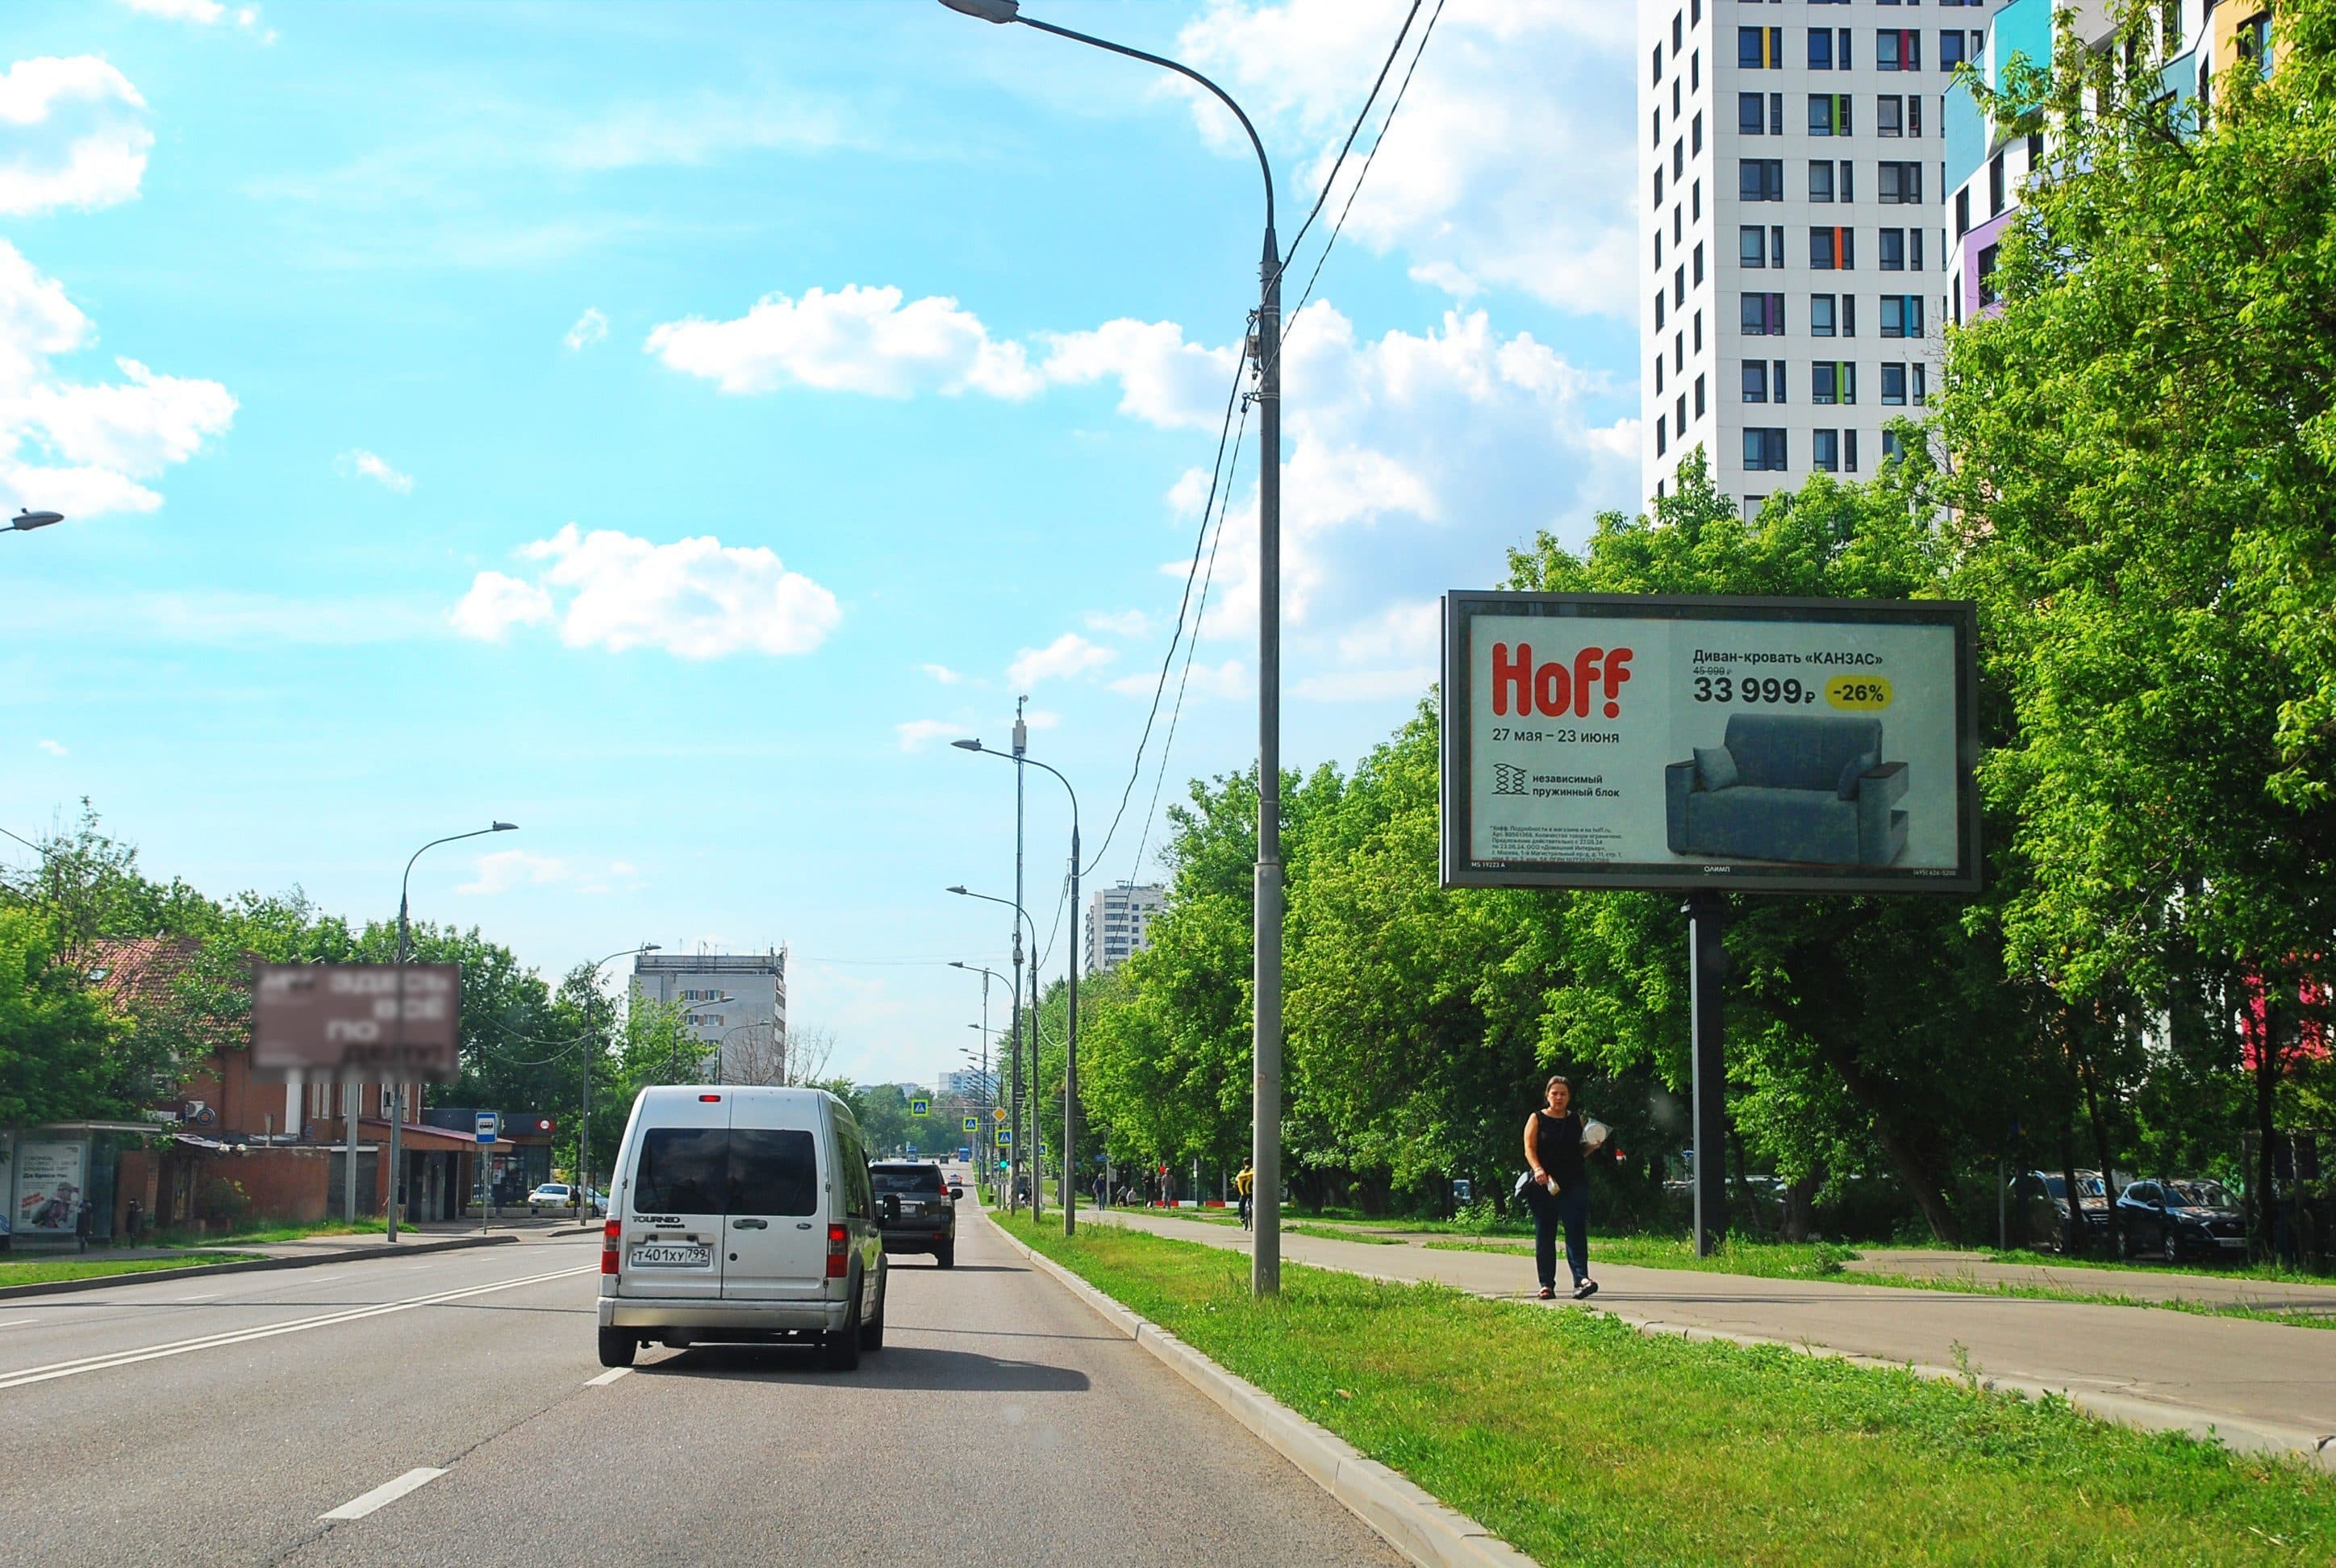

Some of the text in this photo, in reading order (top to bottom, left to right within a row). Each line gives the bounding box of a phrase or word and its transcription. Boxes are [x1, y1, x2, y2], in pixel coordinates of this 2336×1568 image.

[1693, 649, 1883, 665] Диван-кровать «КАНЗАС»
[1693, 677, 1733, 703] 33
[1833, 683, 1884, 702] -26%
[1492, 728, 1510, 741] 27
[1514, 731, 1542, 741] мая
[1558, 729, 1576, 743] 23
[1581, 732, 1620, 744] июня
[1533, 774, 1603, 784] независимый
[1533, 786, 1620, 798] пружинный блок
